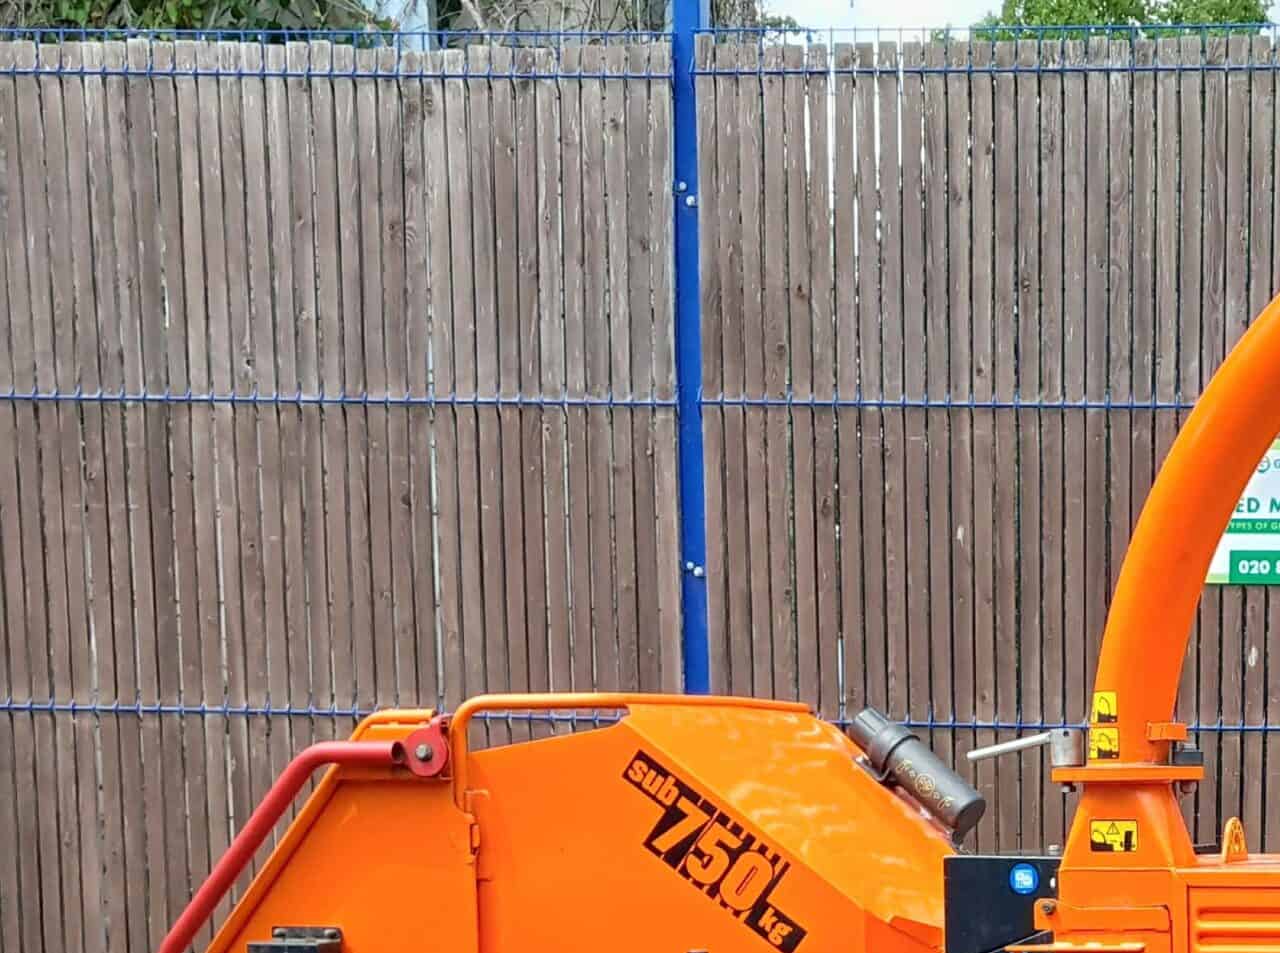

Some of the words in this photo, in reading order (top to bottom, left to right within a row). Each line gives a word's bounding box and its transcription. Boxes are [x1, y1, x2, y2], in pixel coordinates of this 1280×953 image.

[1235, 497, 1260, 513] ED
[1255, 521, 1268, 530] OF
[1238, 559, 1270, 575] 020
[626, 758, 680, 807] sub
[648, 794, 776, 914] 750
[757, 905, 794, 946] kg
